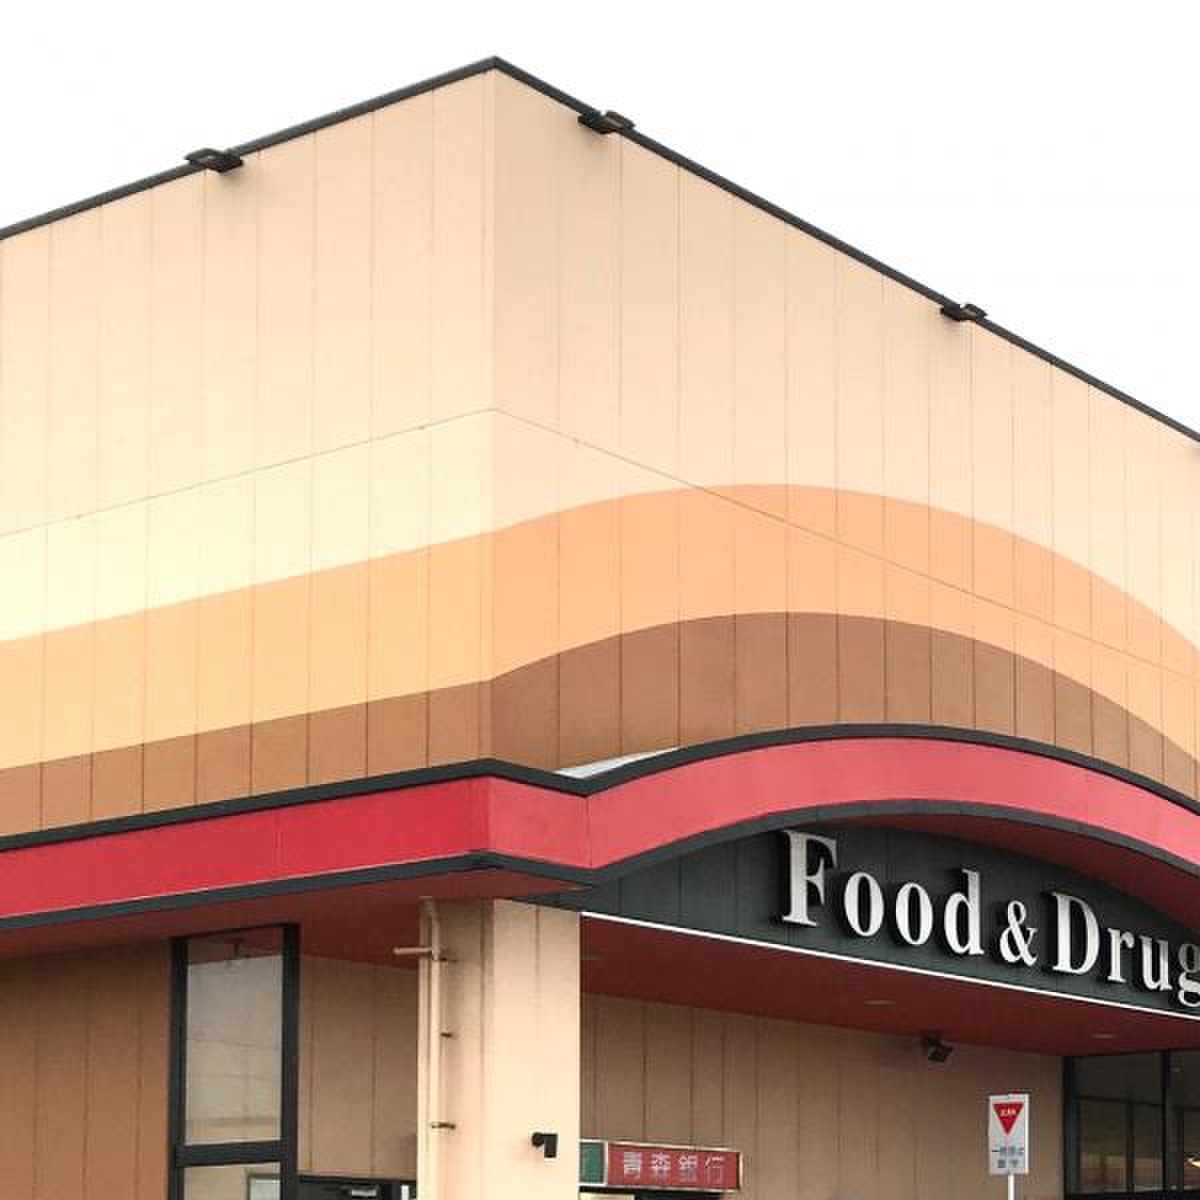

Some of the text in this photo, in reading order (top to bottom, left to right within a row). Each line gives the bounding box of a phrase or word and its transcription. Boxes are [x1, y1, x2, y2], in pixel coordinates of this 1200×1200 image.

[782, 830, 985, 956] Food
[1000, 901, 1038, 967] &
[623, 1151, 725, 1184] 青森銀行
